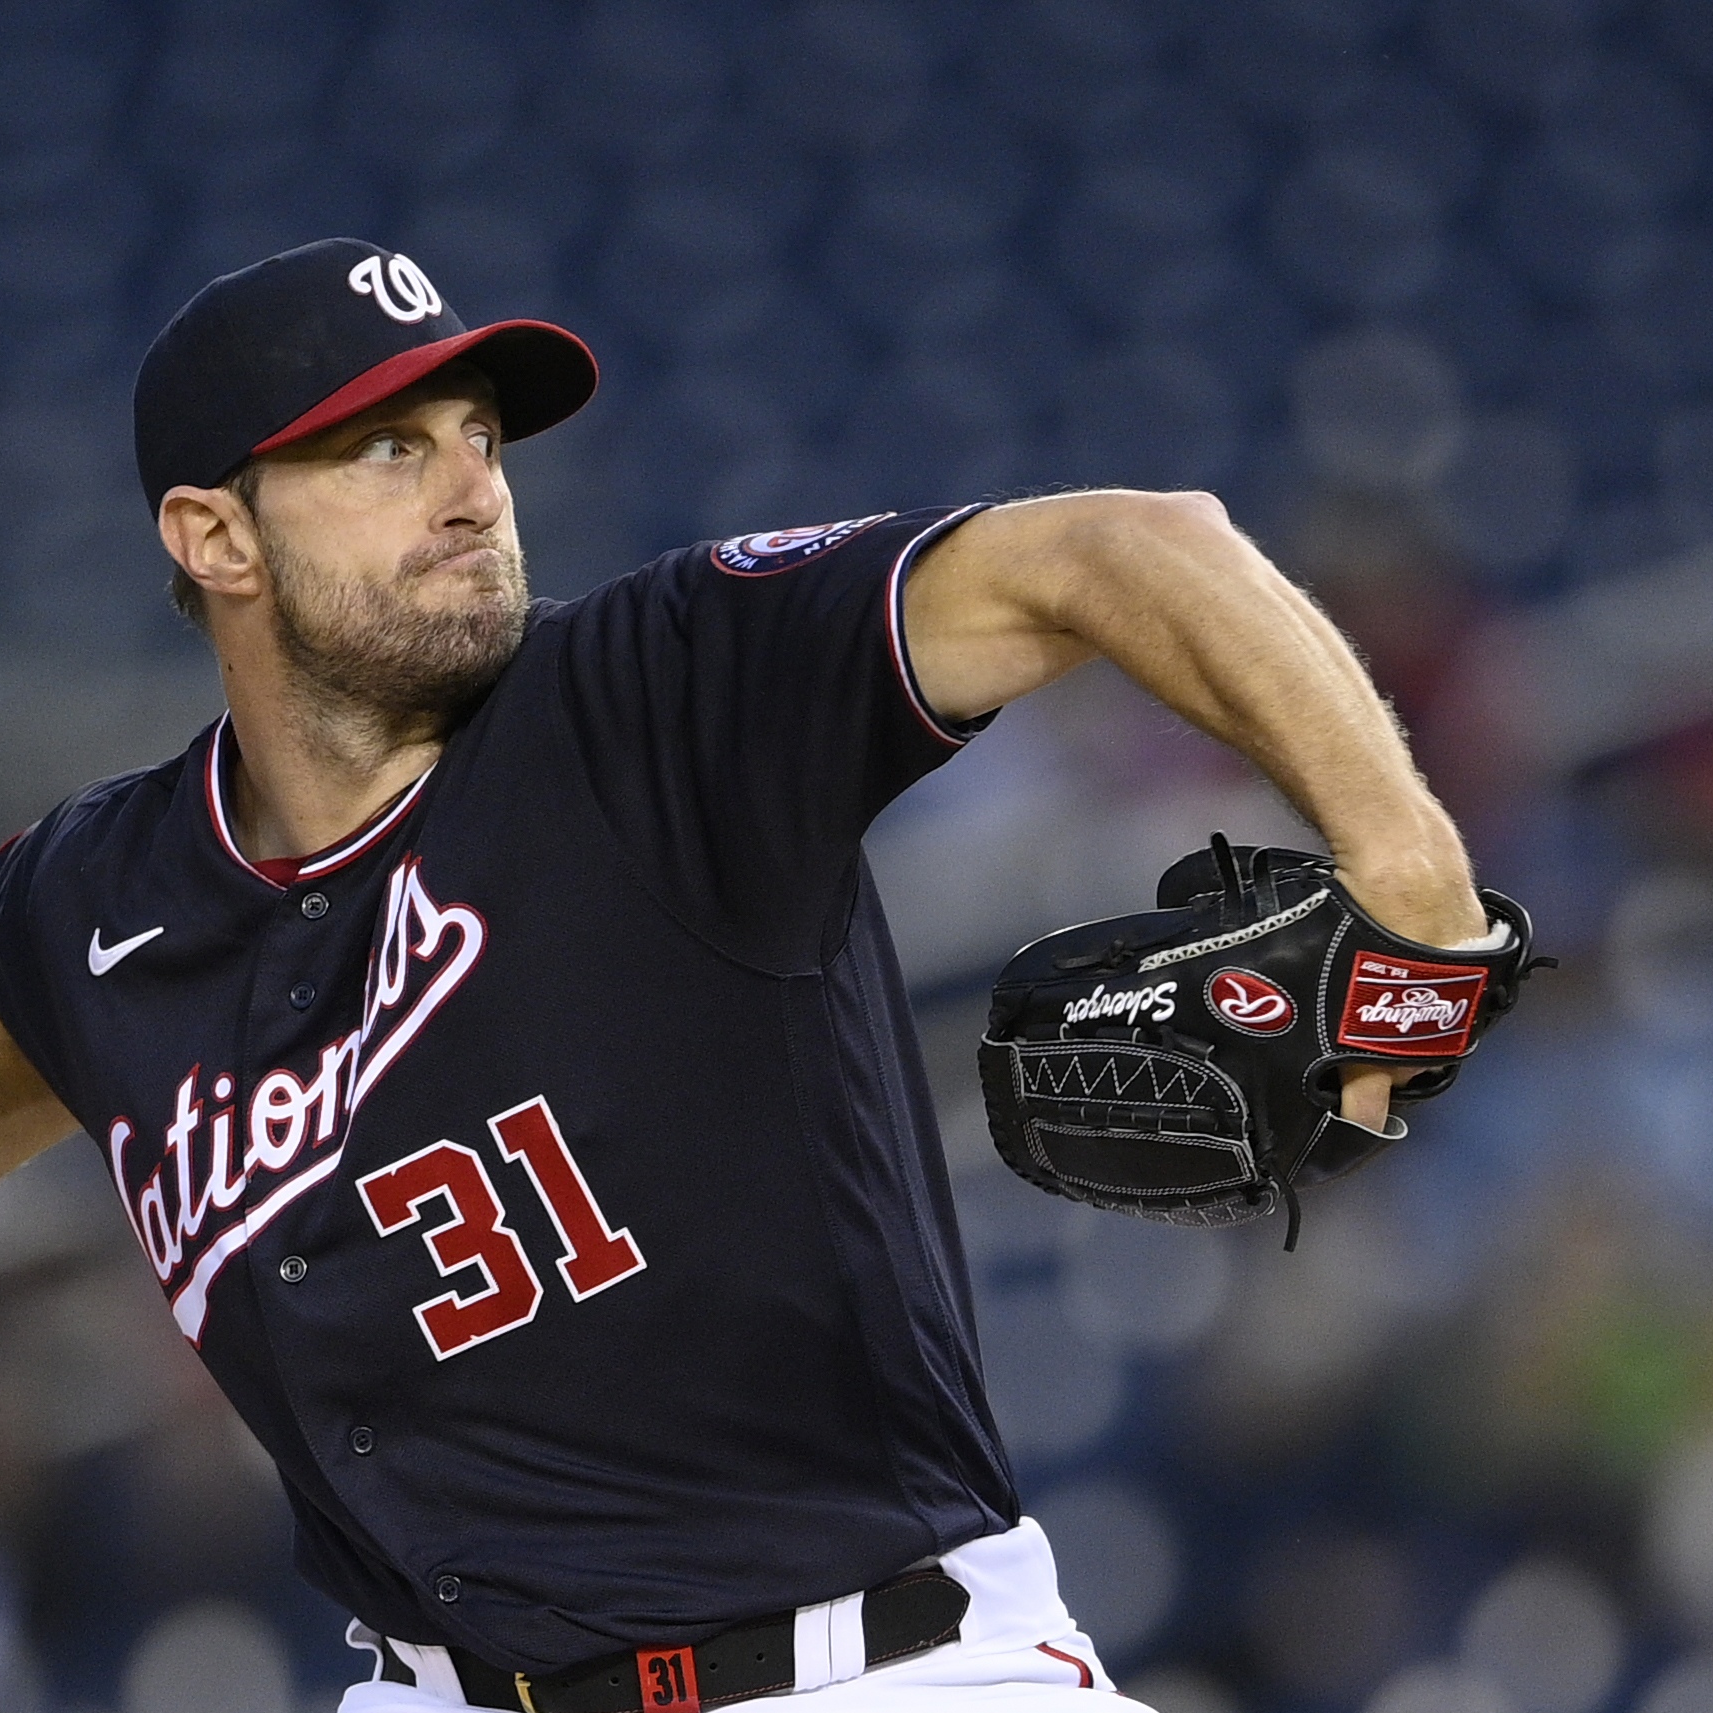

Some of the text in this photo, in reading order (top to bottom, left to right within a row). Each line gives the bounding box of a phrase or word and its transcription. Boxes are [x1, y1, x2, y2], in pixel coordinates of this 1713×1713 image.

[347, 253, 443, 324] W
[1063, 981, 1177, 1026] Scherzer
[1356, 991, 1468, 1033] Rawlings
[355, 1094, 647, 1361] 31
[648, 1652, 688, 1706] 31
